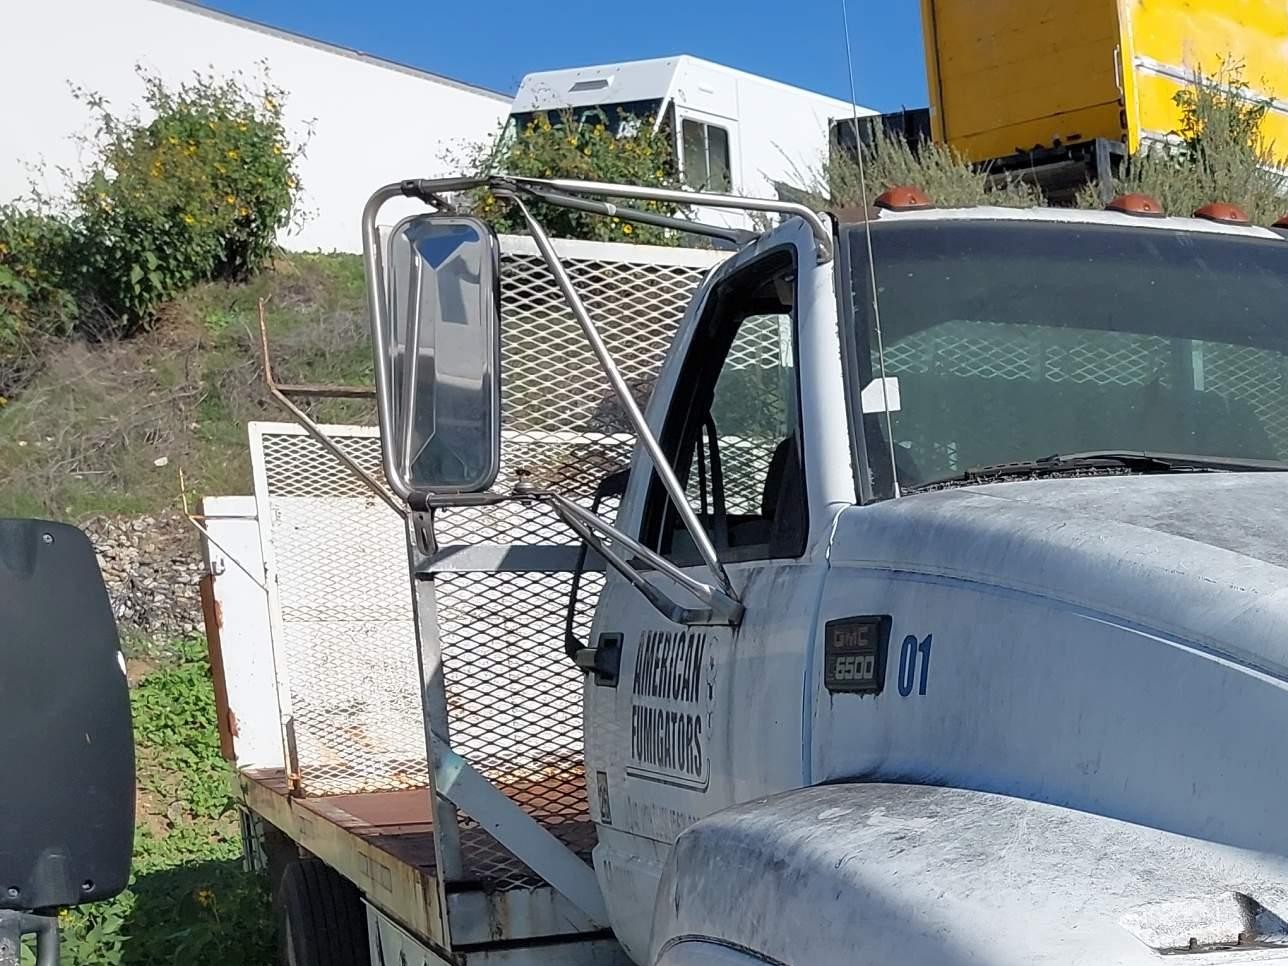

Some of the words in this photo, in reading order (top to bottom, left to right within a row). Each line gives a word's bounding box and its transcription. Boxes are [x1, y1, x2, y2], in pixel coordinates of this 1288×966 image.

[633, 630, 706, 704] AMERICAN
[833, 626, 869, 648] GMC
[834, 655, 875, 680] 6500
[898, 633, 933, 697] 01
[632, 704, 702, 777] FUMIGATORS
